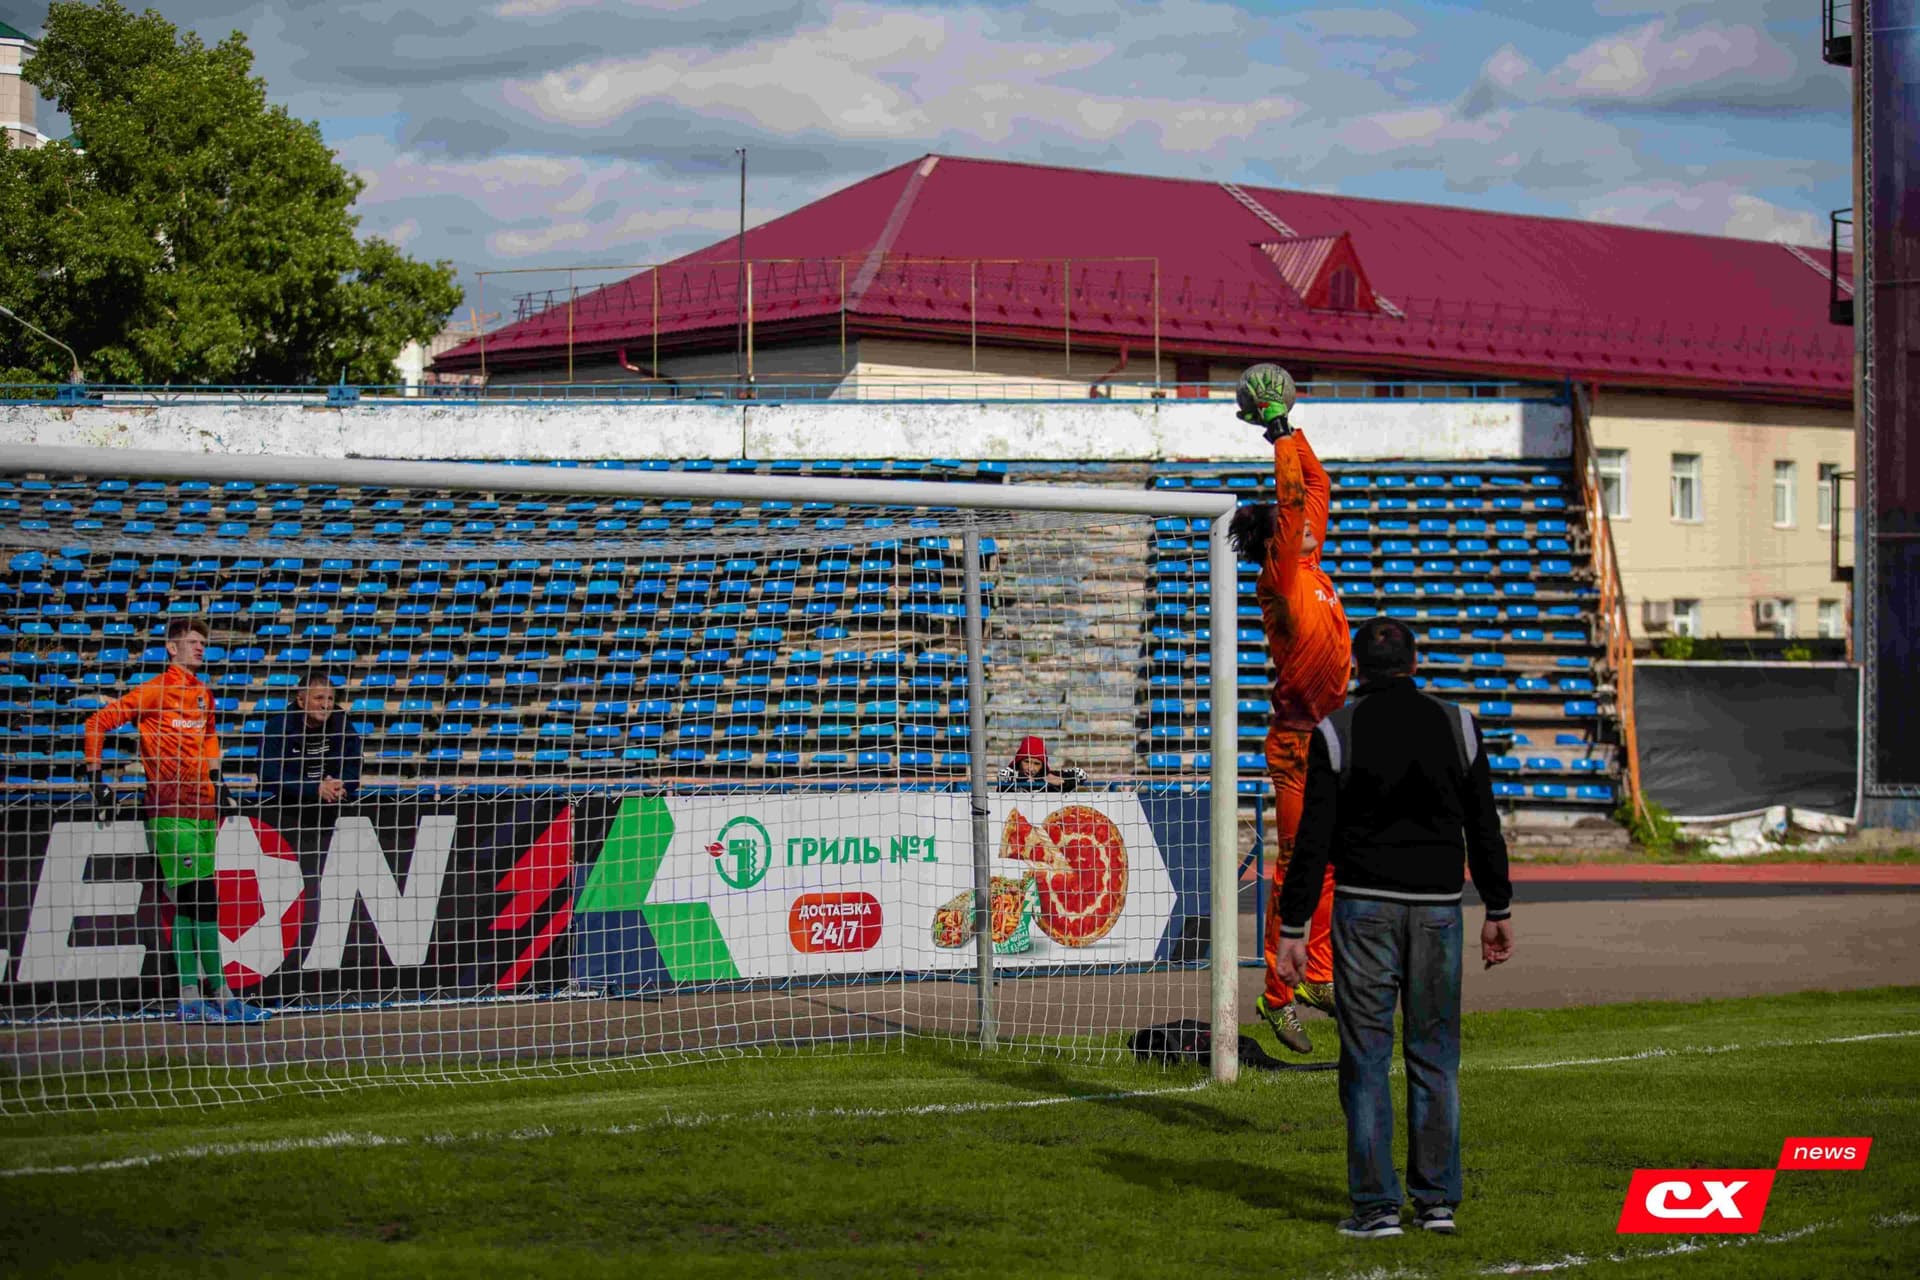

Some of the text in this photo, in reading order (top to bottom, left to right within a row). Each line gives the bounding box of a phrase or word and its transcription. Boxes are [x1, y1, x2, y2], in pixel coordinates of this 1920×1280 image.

[786, 834, 939, 867] ГРИЛЬ №1
[798, 902, 872, 920] ДОСТАВКА
[811, 920, 859, 946] 24/7
